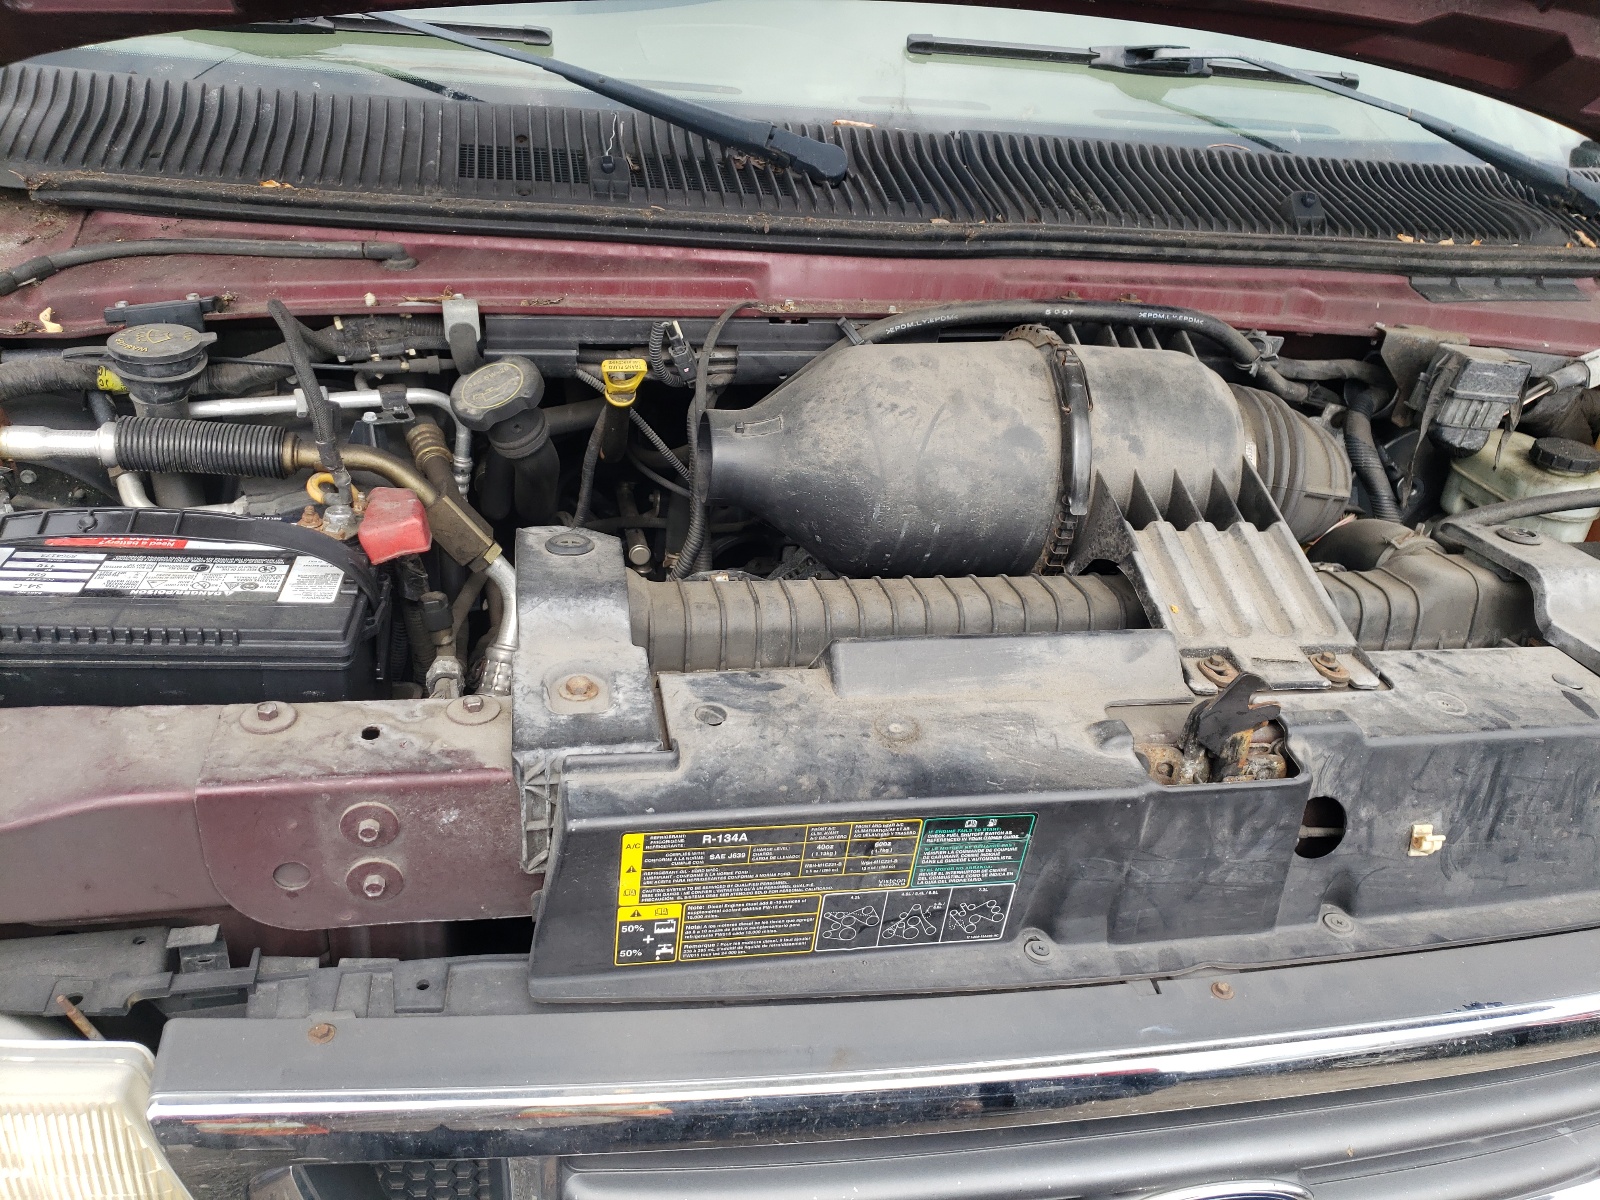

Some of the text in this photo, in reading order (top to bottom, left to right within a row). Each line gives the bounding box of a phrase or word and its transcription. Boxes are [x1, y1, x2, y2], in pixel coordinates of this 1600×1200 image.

[702, 832, 749, 844] R-134A
[621, 924, 645, 933] 50%
[619, 949, 643, 958] 50%
